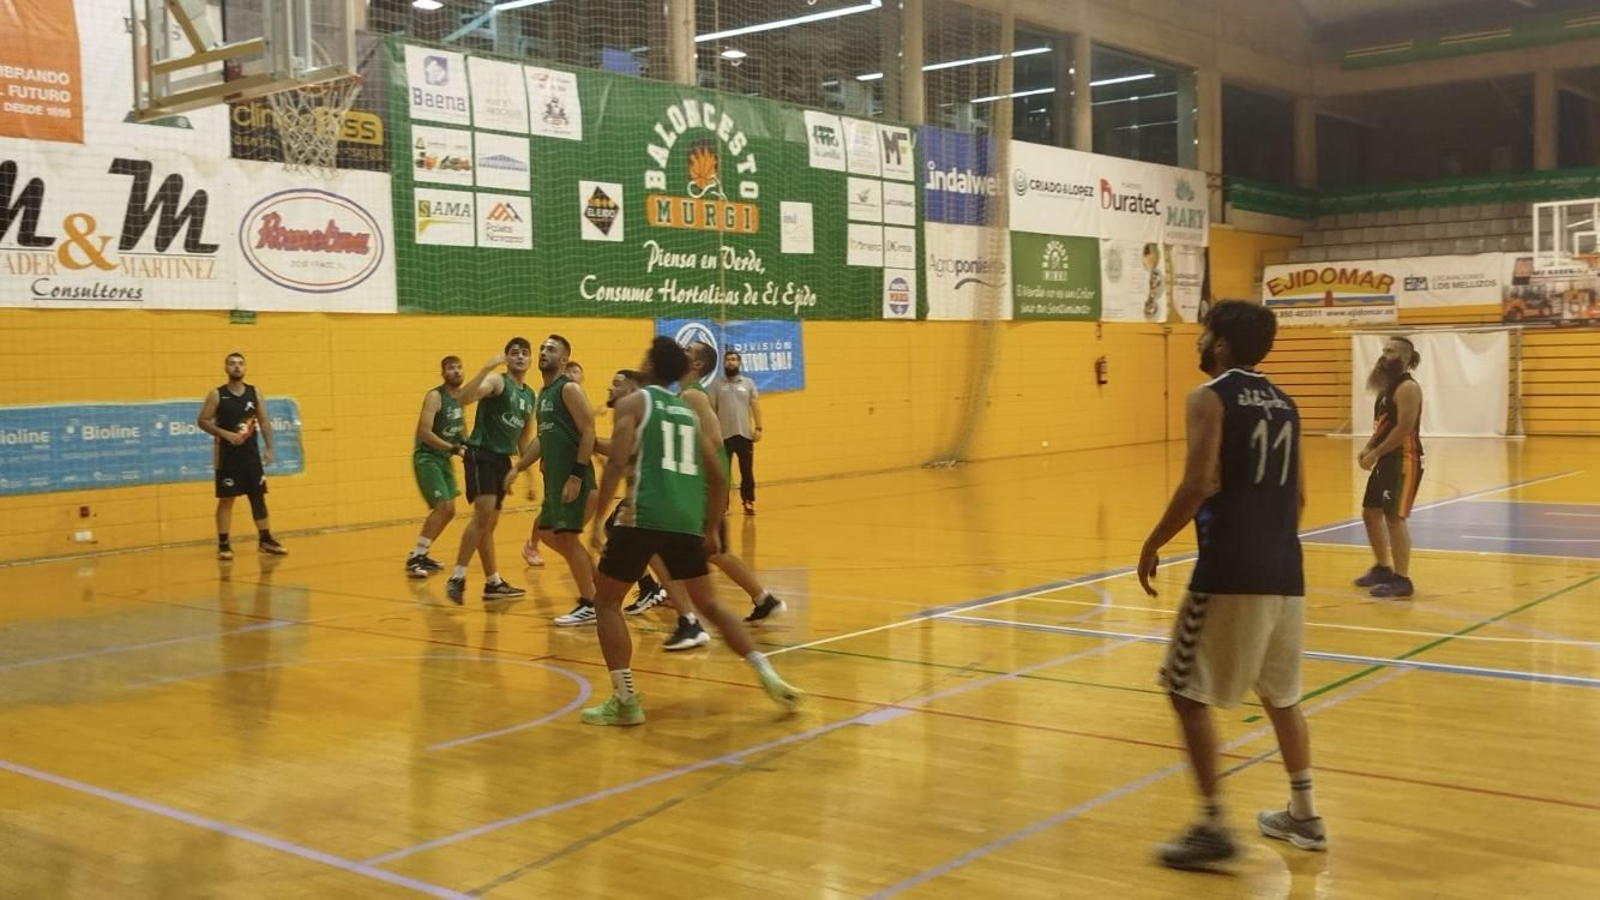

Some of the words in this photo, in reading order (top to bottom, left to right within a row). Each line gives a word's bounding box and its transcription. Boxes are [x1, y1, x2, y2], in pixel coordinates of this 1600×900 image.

[3, 102, 45, 115] DESDE
[8, 84, 72, 103] FUTURO
[412, 87, 467, 112] Baena
[644, 99, 759, 199] BALONCESTO
[418, 199, 472, 218] SAMA
[656, 199, 752, 230] MURGI
[643, 240, 697, 273] Piensa
[702, 252, 717, 269] en
[720, 245, 766, 275] Verde,
[31, 277, 144, 299] Consultores
[579, 275, 654, 303] Consume
[743, 283, 760, 306] de
[762, 281, 779, 307] El
[782, 281, 817, 316] Ejido
[1266, 267, 1396, 297] EJIDOMAR
[82, 424, 140, 440] Bioline
[661, 420, 699, 476] 11
[1250, 418, 1293, 487] 11
